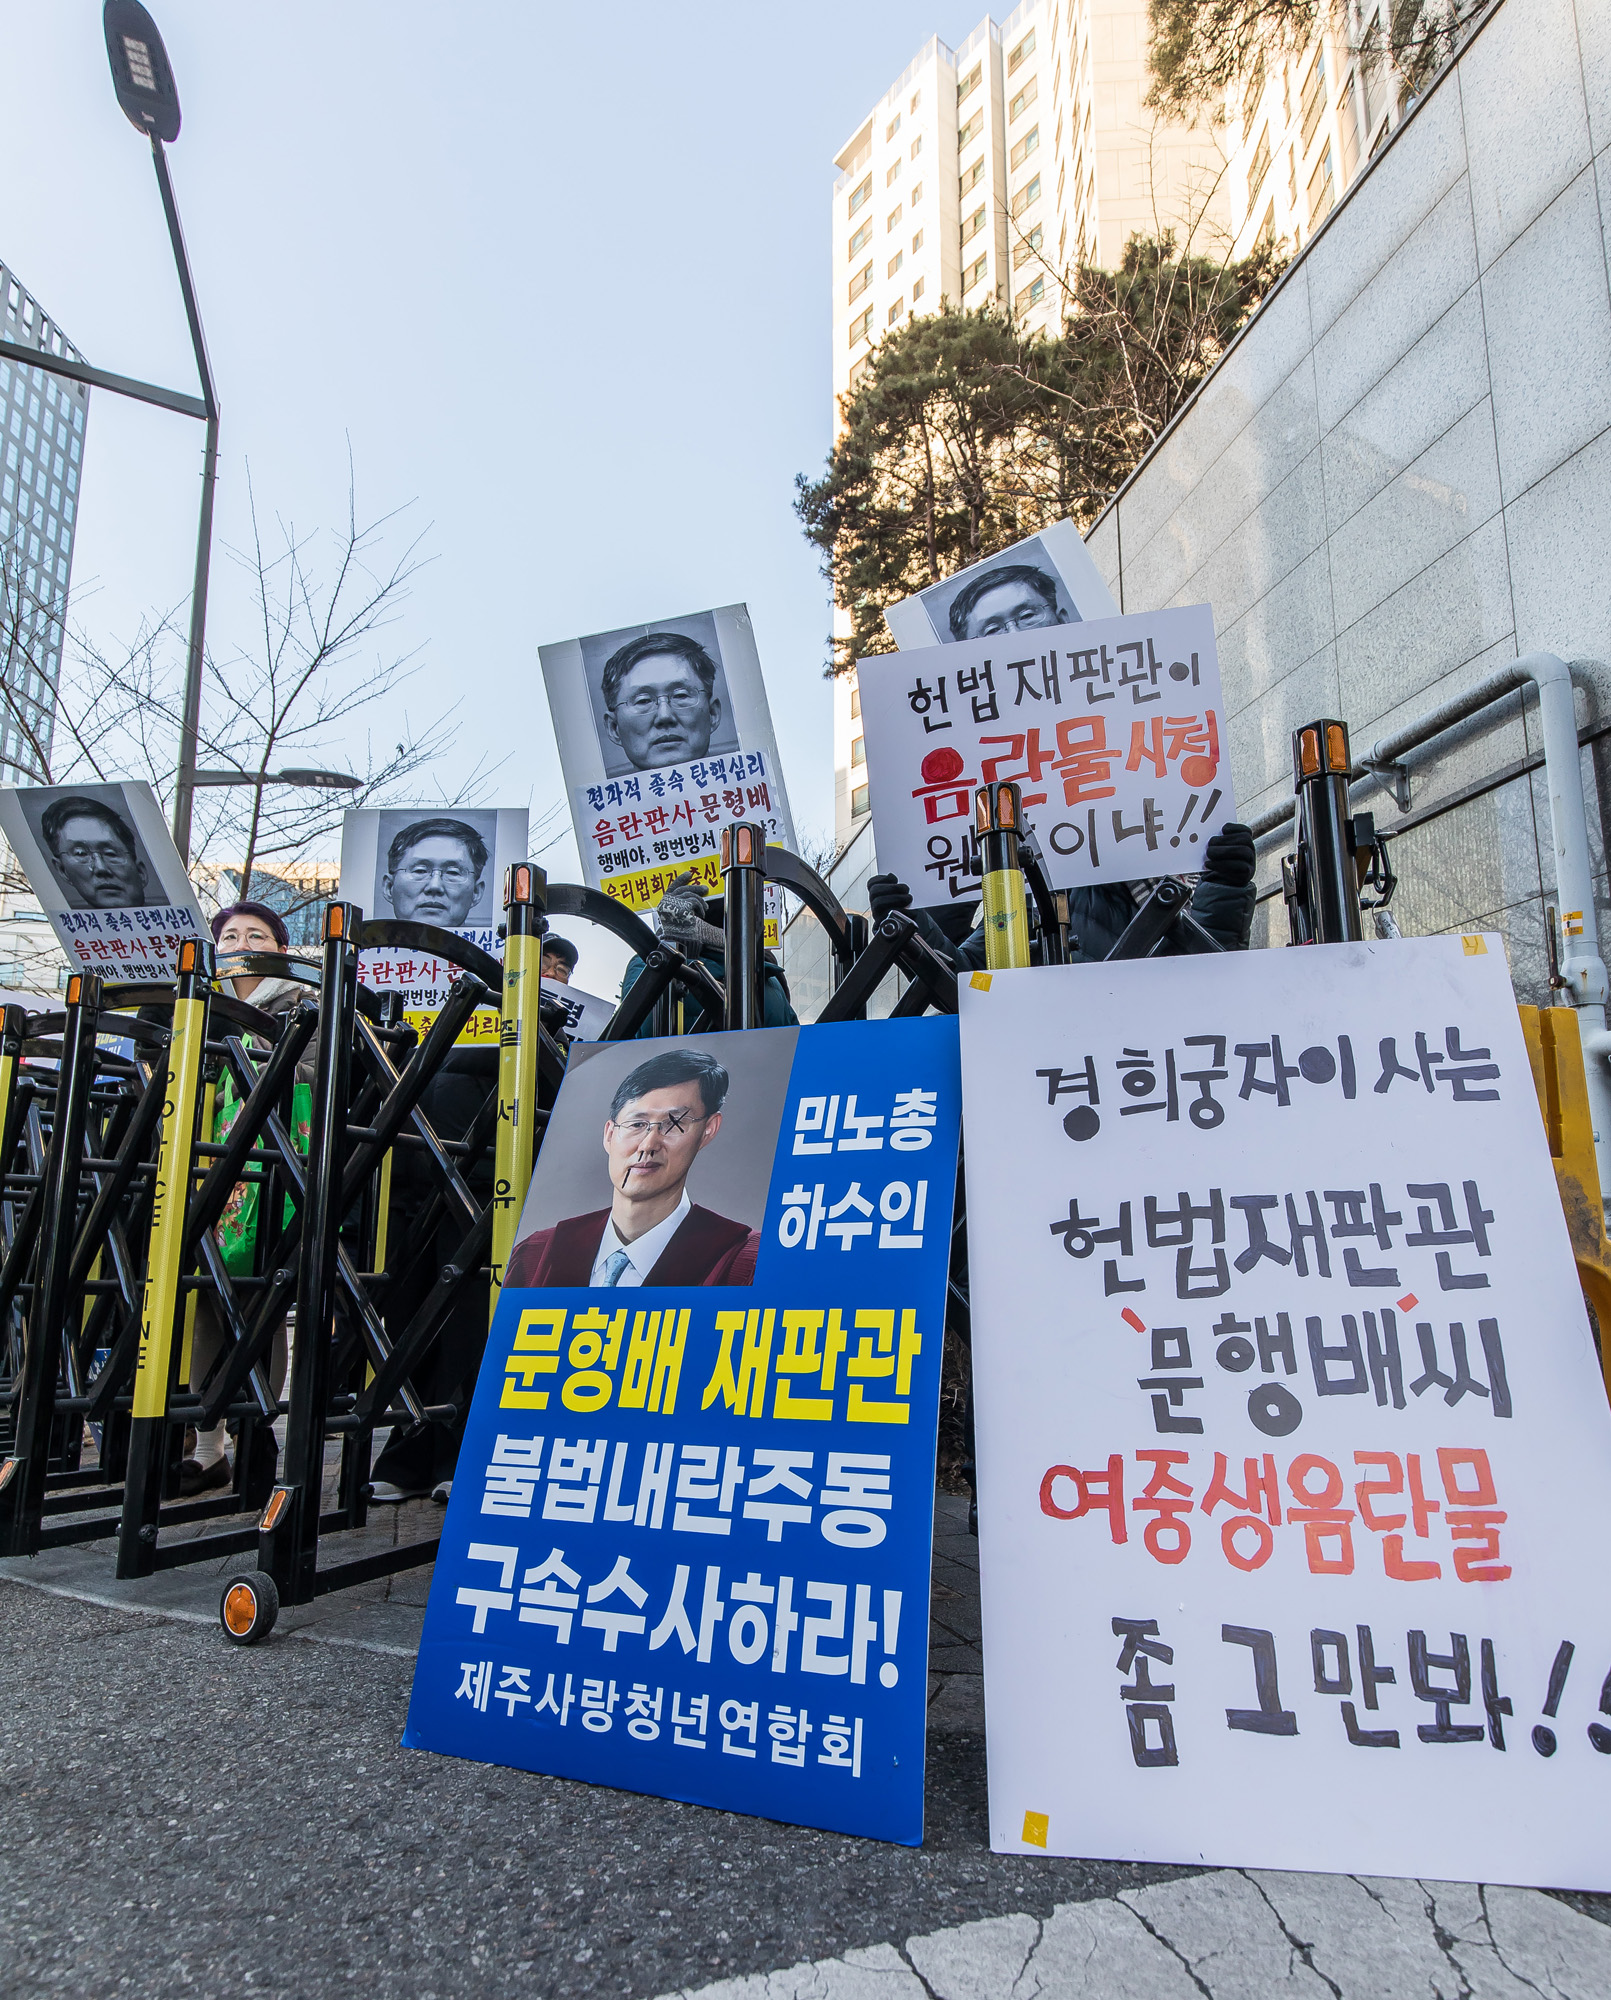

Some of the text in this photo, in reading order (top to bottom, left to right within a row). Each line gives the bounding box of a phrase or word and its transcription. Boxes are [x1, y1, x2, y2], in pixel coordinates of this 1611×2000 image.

[648, 769, 684, 797] 졸속
[925, 788, 1223, 899] 웬이냐!!
[792, 1088, 937, 1156] 민노총
[778, 1180, 928, 1251] 하수인
[499, 1307, 922, 1424] 문형배 재판관
[1111, 1617, 1179, 1768] 좀
